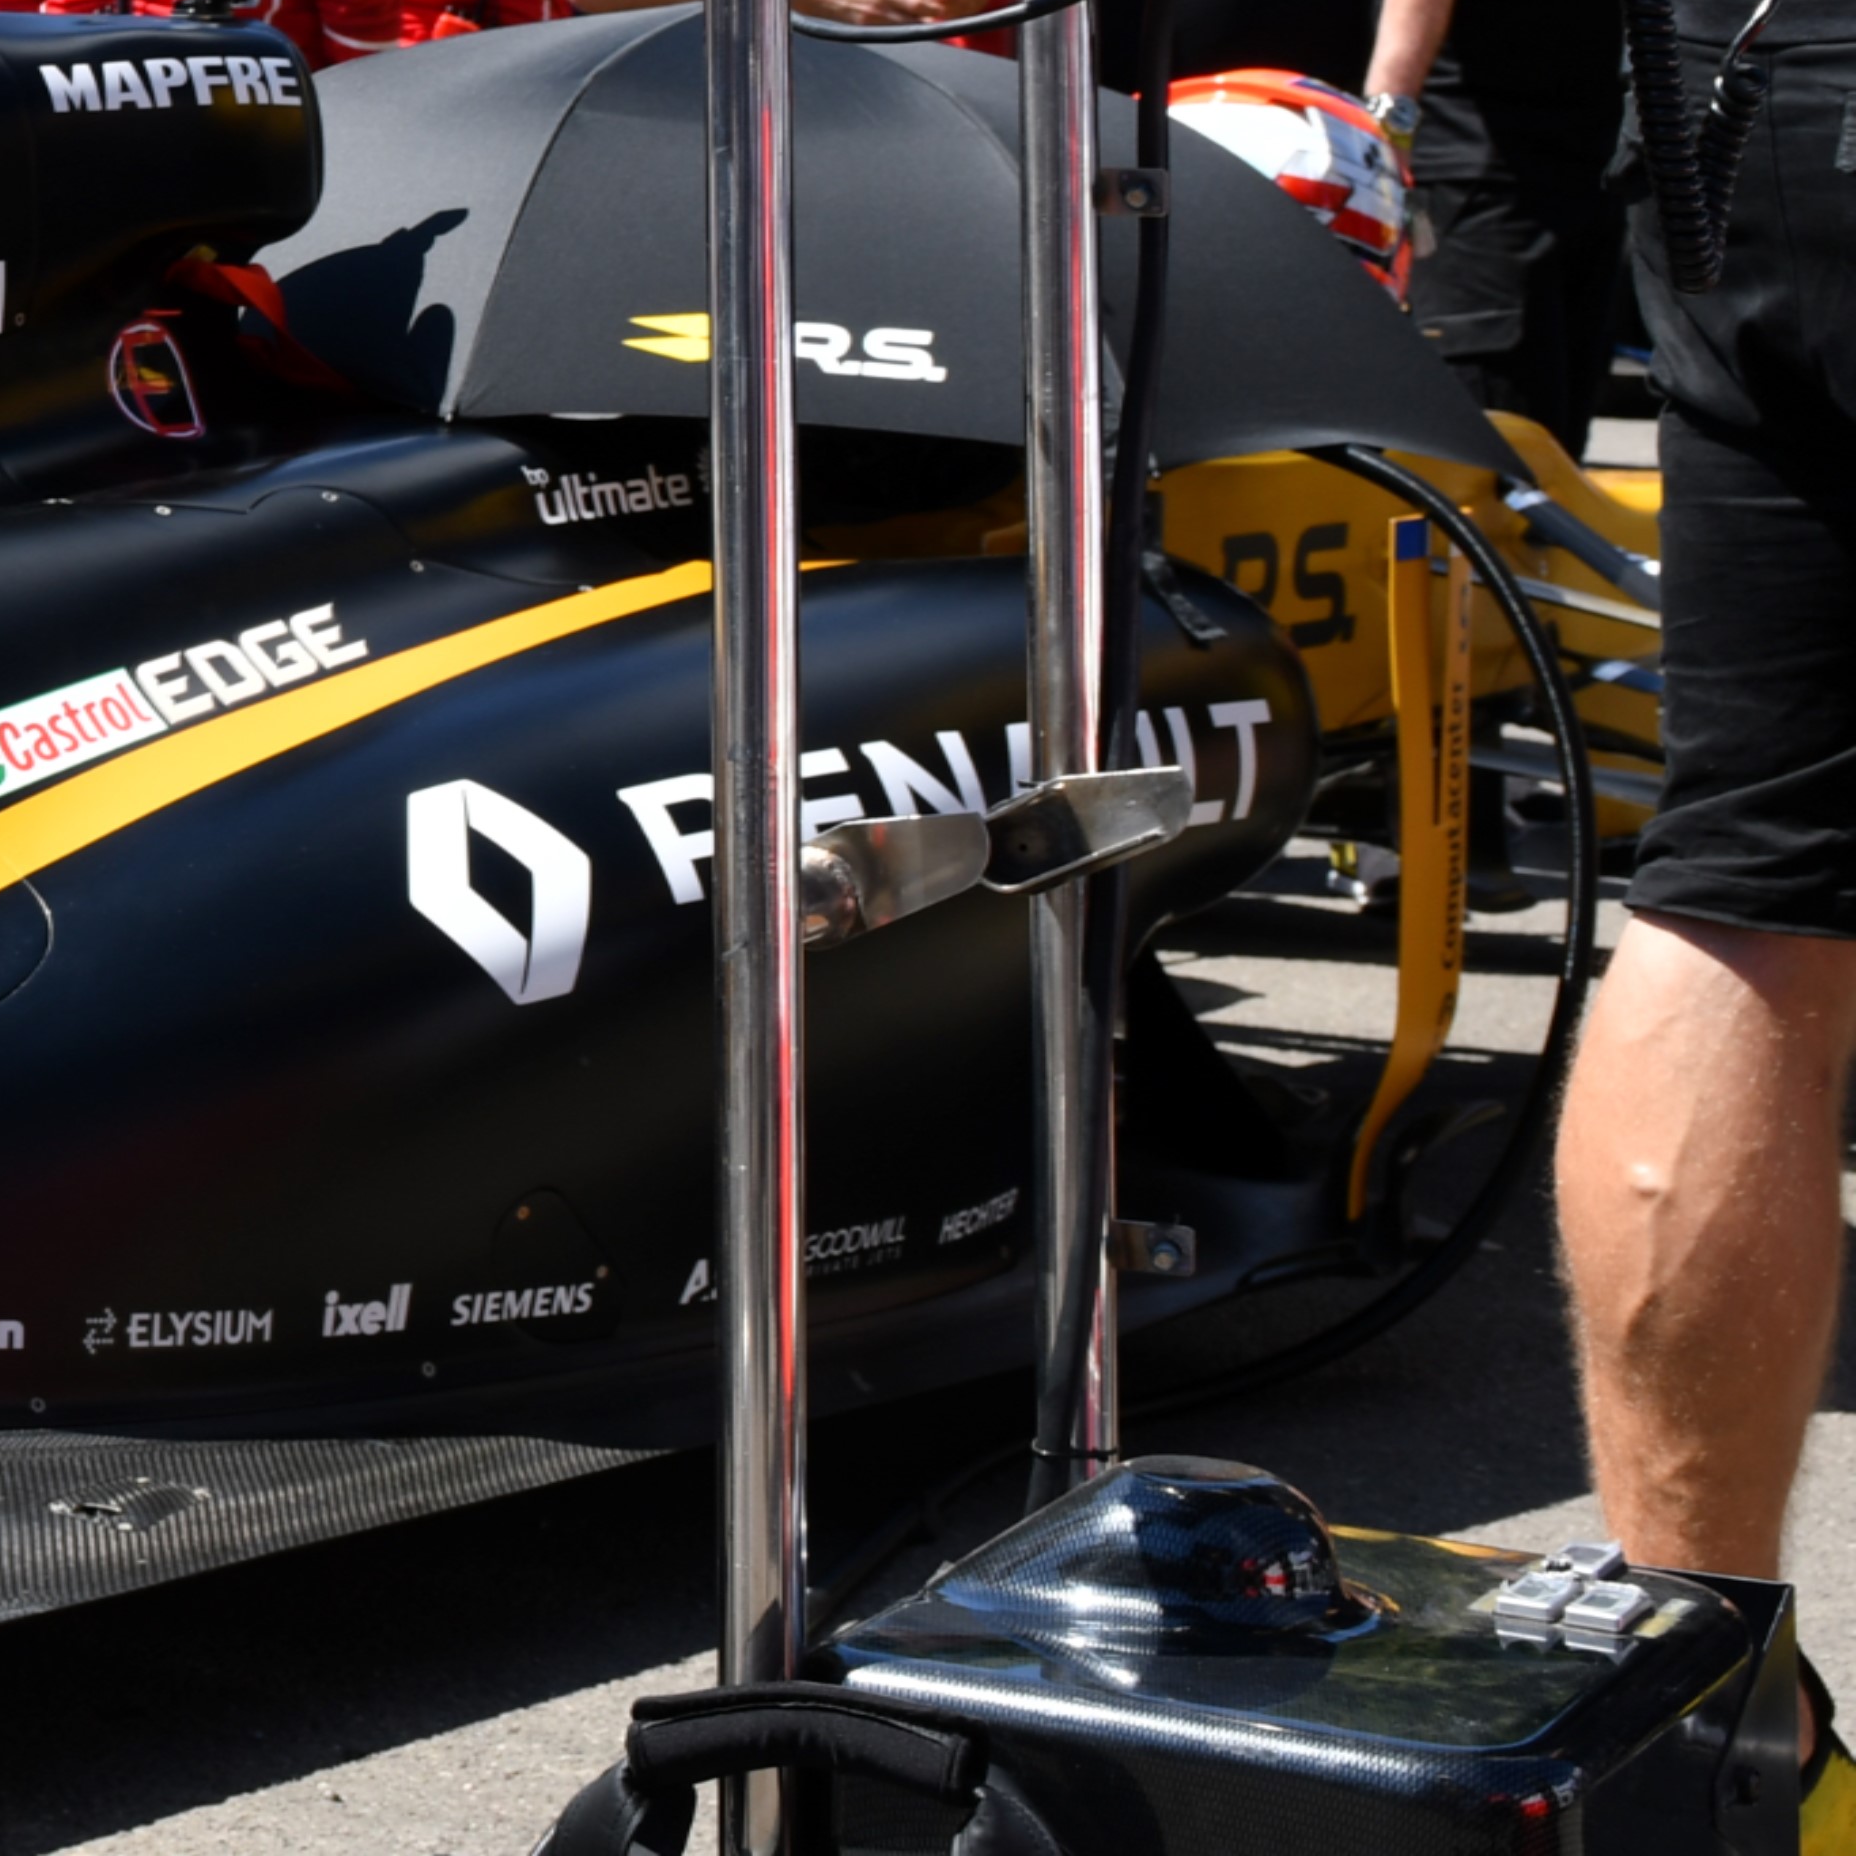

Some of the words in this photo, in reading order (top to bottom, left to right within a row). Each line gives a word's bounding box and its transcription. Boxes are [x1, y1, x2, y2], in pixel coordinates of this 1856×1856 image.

[39, 56, 304, 114] MAPFRE
[135, 601, 370, 726] EDGE
[127, 1309, 274, 1349] ELYSIUM
[322, 1282, 413, 1338] ixell
[450, 1282, 595, 1327] SIEMENS
